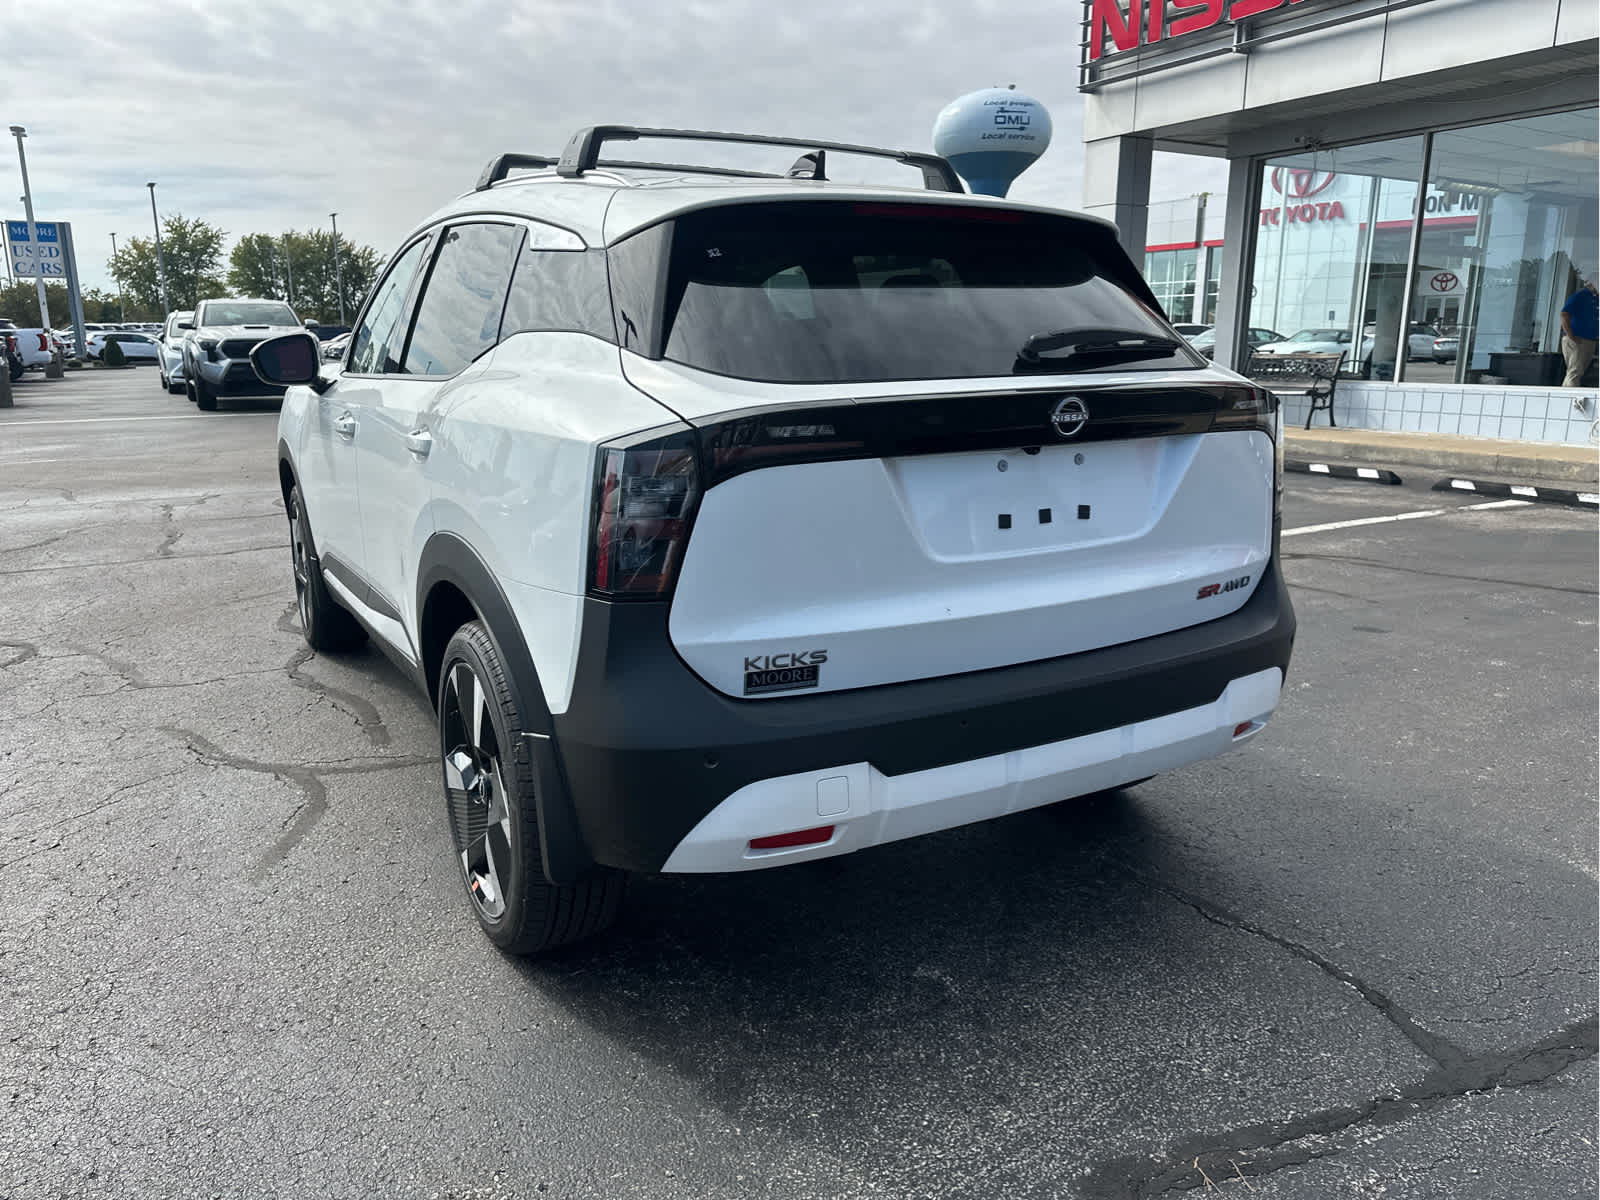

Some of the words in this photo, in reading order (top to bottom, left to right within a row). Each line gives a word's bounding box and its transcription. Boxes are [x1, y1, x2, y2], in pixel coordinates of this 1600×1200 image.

[994, 115, 1030, 125] OMU
[982, 132, 1007, 140] Local
[13, 245, 60, 257] USED
[1051, 414, 1088, 422] NISSAN
[1196, 583, 1221, 600] SR
[1219, 576, 1251, 595] AWD
[744, 649, 828, 672] KICKS
[752, 667, 814, 687] MOORE
